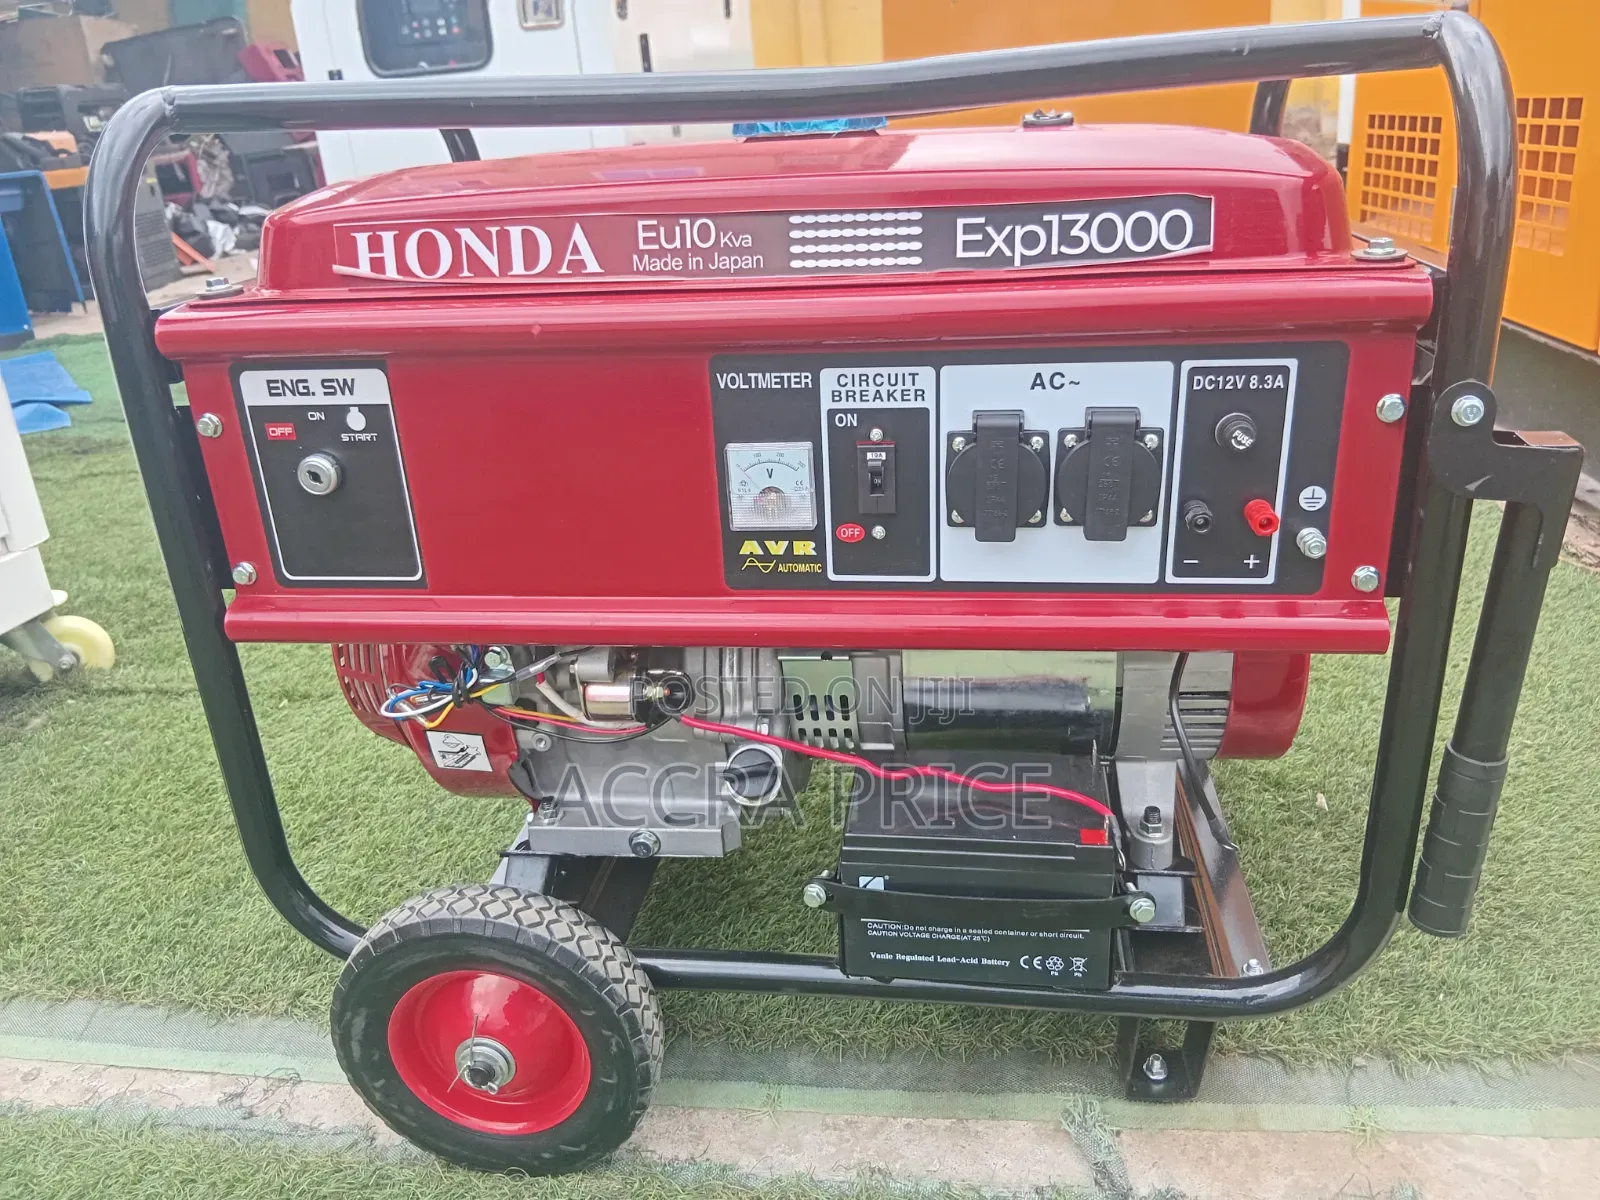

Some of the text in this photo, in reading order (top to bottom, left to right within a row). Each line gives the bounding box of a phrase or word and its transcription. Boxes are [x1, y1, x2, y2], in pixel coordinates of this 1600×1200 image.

[637, 218, 753, 250] Eu10 Kva
[955, 208, 1194, 267] Exp13000
[350, 222, 604, 279] HONDA
[632, 252, 764, 273] Made in Japan
[716, 372, 812, 389] VOLTMETER
[837, 373, 919, 387] CIRCUIT
[1192, 374, 1284, 390] DC12V 8.3A
[265, 378, 355, 397] ENG. SW
[831, 389, 926, 402] BREAKER
[308, 411, 325, 420] ON
[834, 413, 858, 427] ON
[269, 427, 292, 436] OFF
[341, 433, 378, 441] START
[1232, 430, 1253, 447] FUSE
[766, 468, 773, 479] V
[840, 528, 860, 538] OFF
[739, 540, 818, 556] AVR
[778, 563, 822, 573] AUTOMATIC
[899, 931, 931, 939] VOLTAGE
[969, 927, 993, 935] sealed
[994, 929, 1028, 937] container
[896, 953, 934, 962] Regulated
[937, 955, 979, 964] Lead-Acid
[981, 957, 1011, 967] Battery
[1020, 955, 1043, 970] CE
